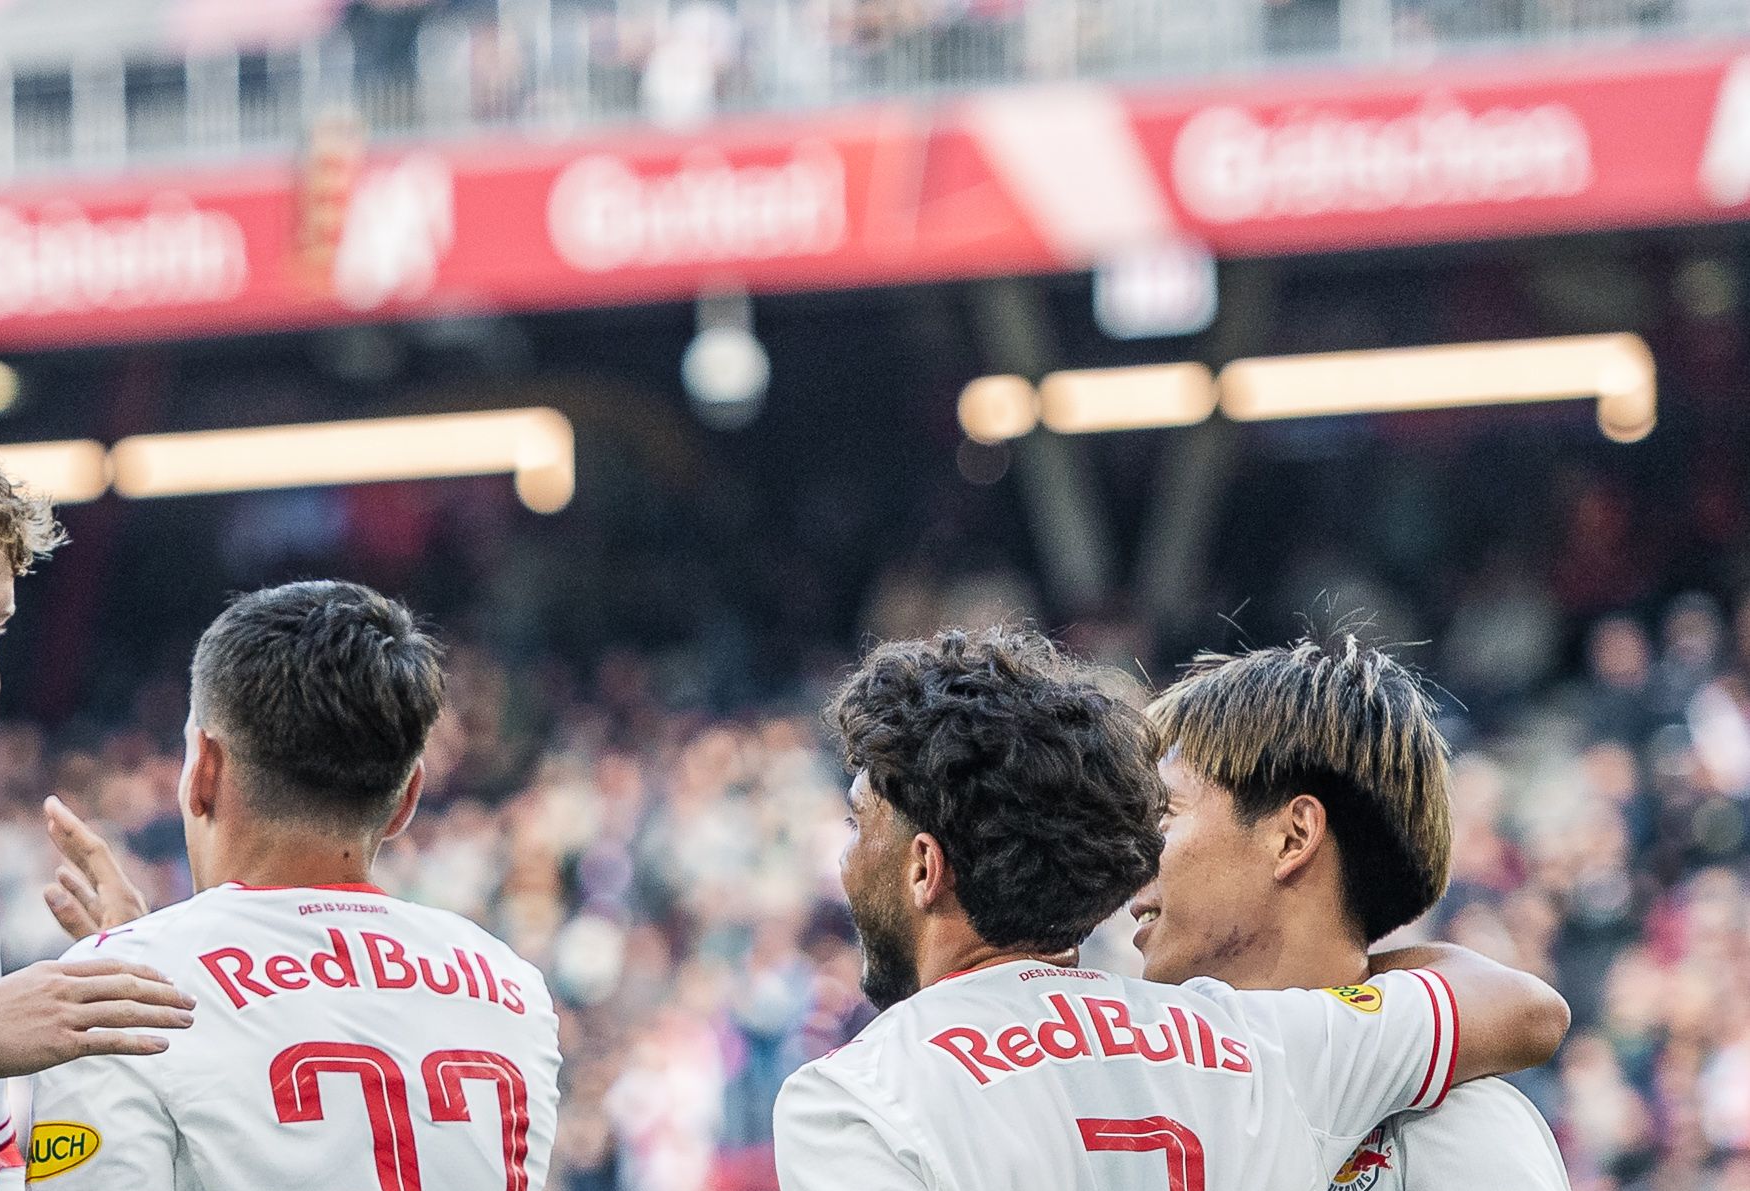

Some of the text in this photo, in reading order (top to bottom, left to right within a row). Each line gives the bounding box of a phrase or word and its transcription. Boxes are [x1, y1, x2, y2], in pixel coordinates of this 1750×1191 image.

[199, 928, 525, 1015] Red Bulls
[928, 993, 1253, 1086] Red Bulls
